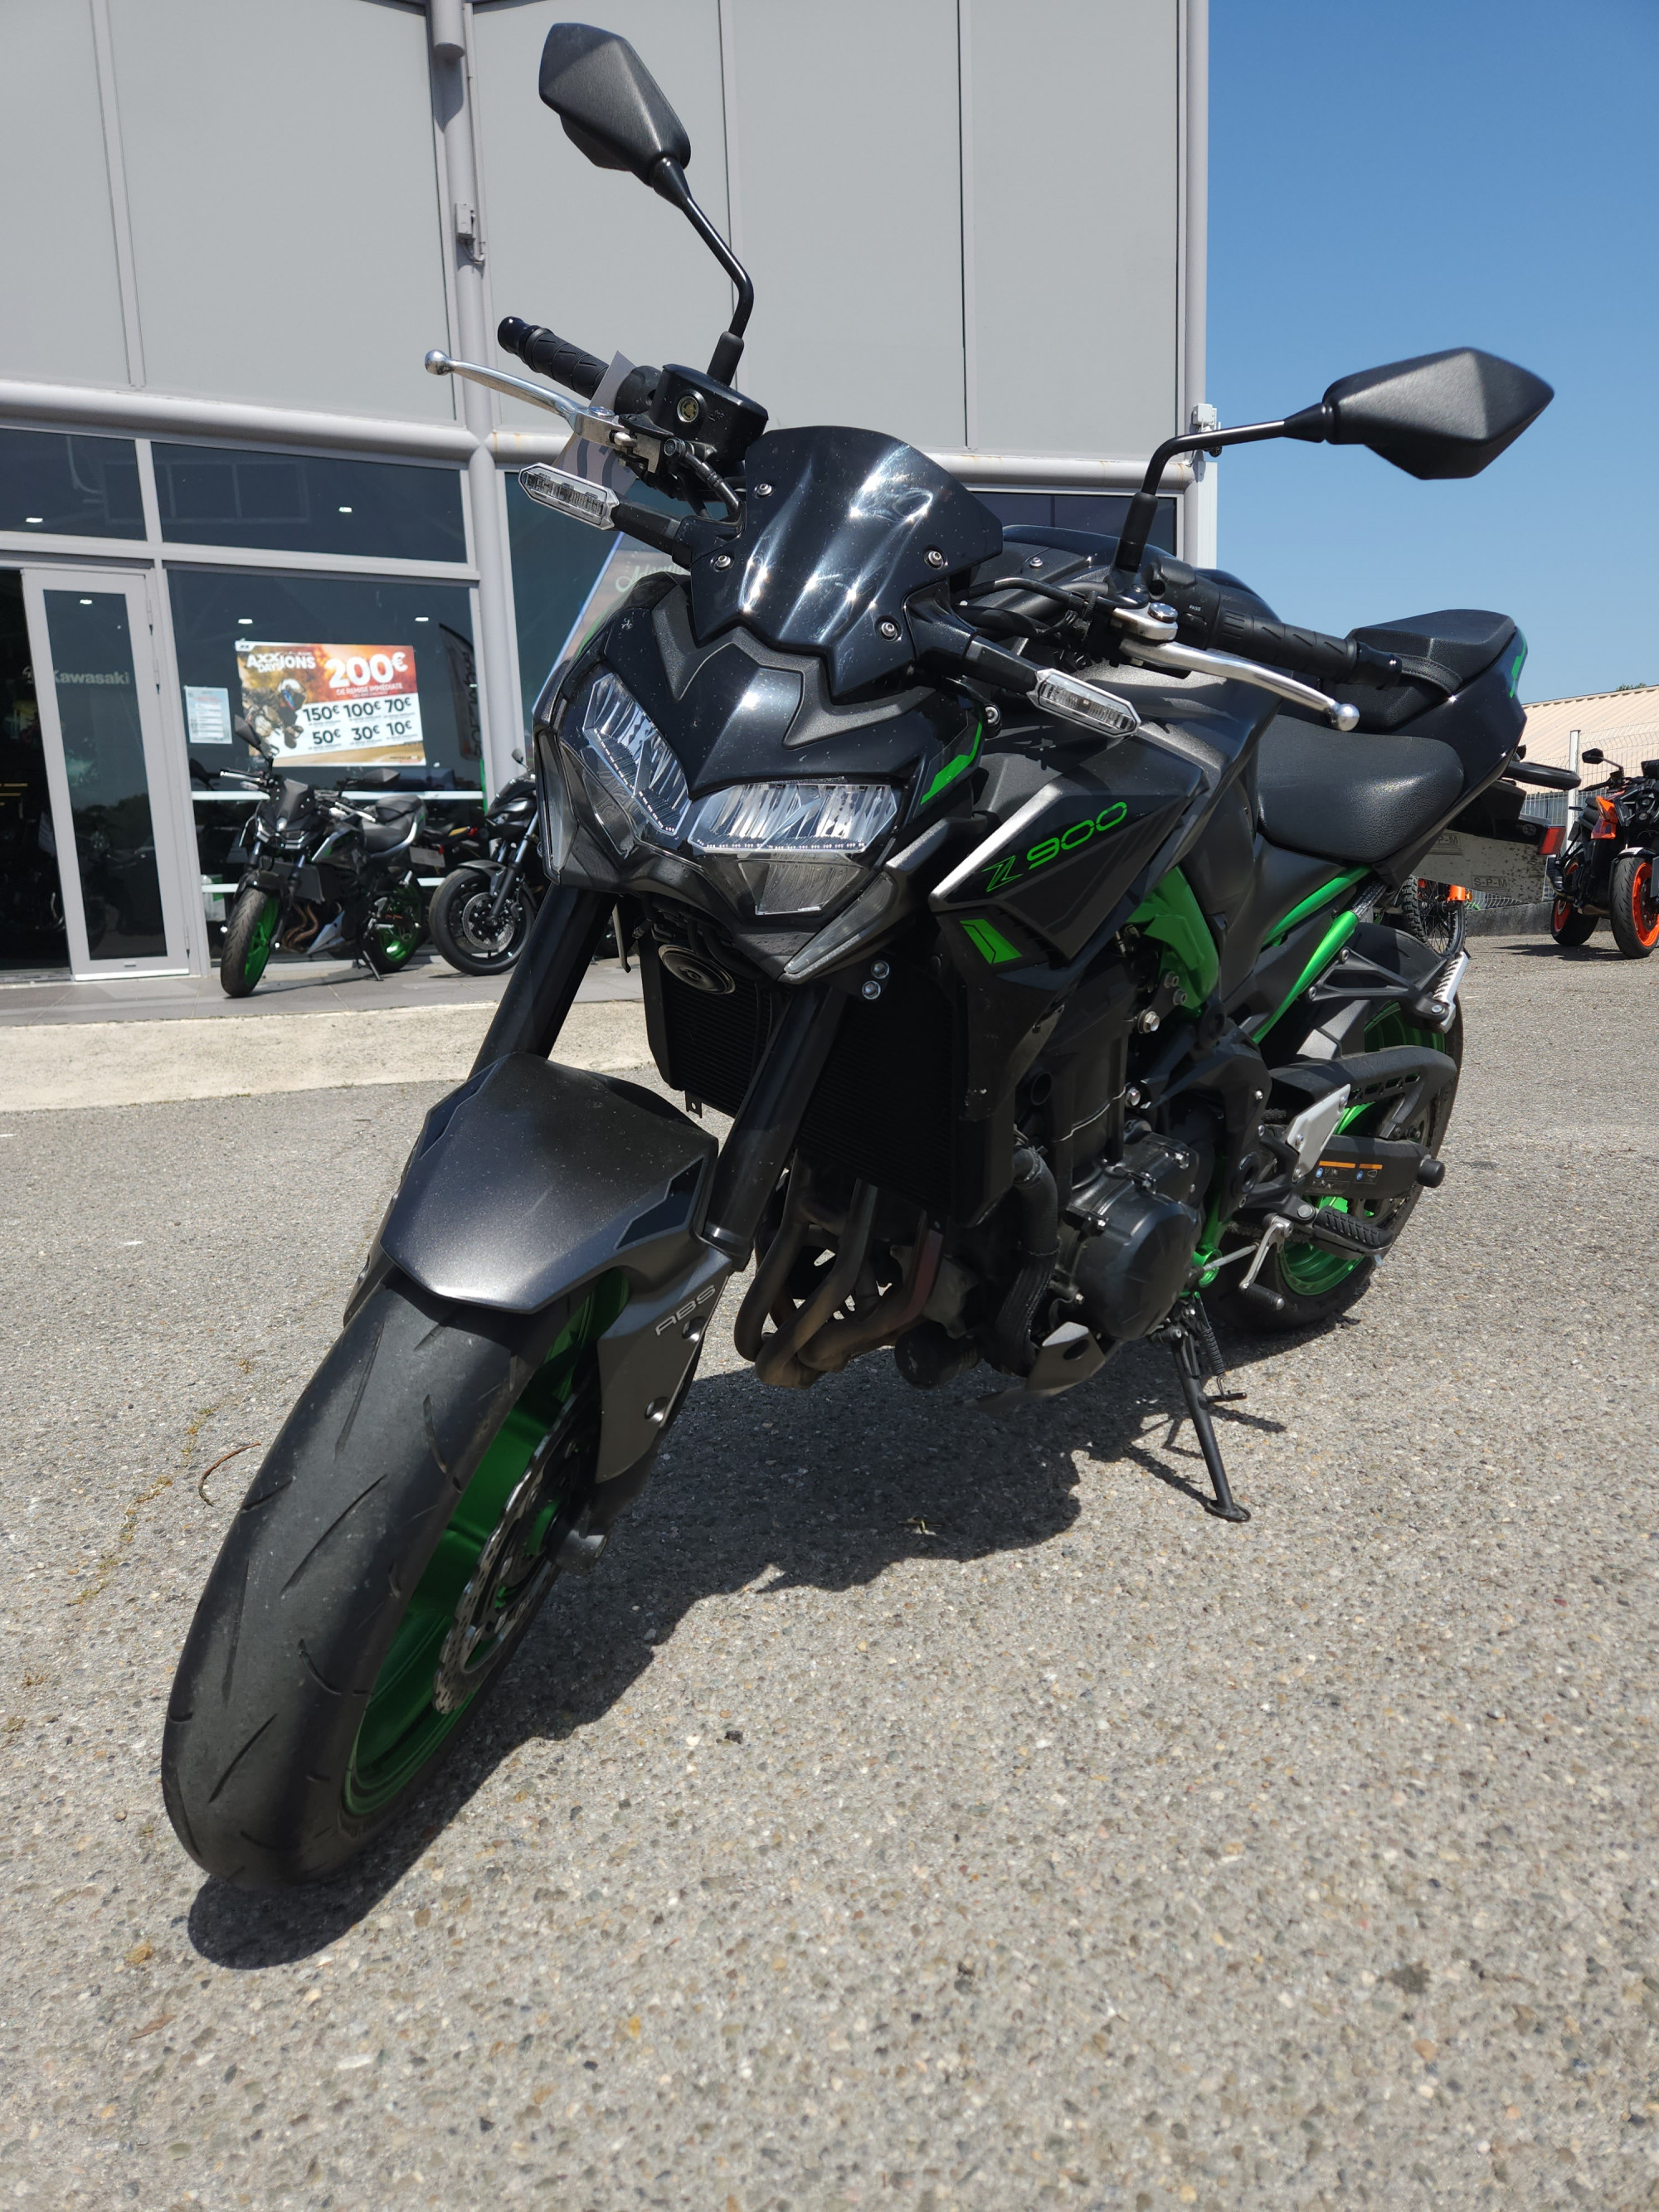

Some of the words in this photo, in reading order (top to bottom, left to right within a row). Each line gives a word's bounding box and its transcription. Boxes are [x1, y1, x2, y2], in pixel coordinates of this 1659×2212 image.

[54, 669, 130, 684] Kawasaki
[324, 651, 408, 688] 200€
[303, 705, 340, 722] 150€
[343, 701, 381, 717] 100€
[384, 698, 411, 712] 70€
[312, 729, 341, 745] 50€
[351, 725, 380, 741] 30€
[386, 720, 412, 736] 10€
[654, 1284, 716, 1336] ABS
